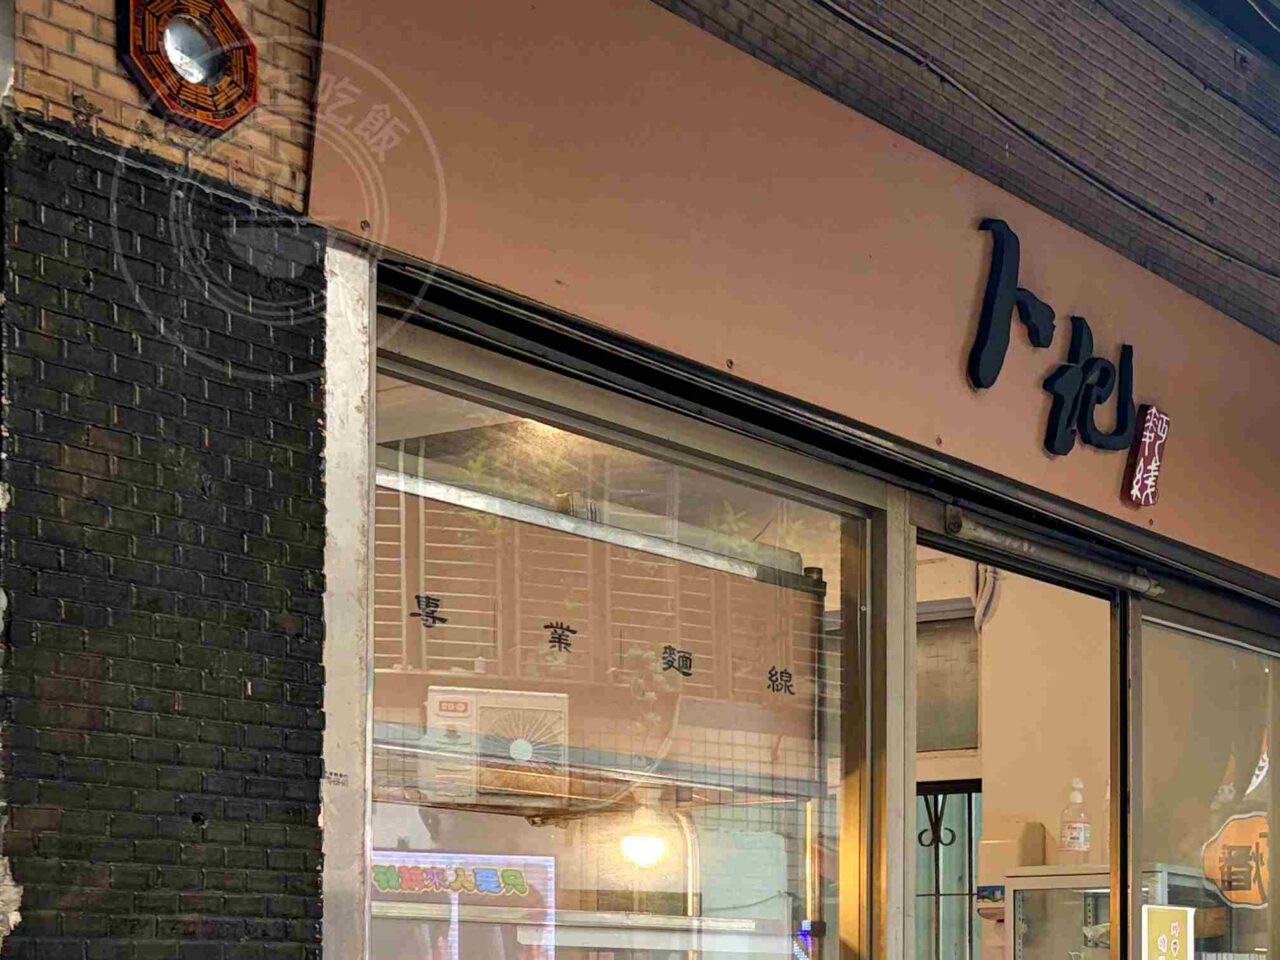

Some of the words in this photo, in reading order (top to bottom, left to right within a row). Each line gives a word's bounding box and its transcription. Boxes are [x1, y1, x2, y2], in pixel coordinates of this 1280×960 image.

[967, 217, 1136, 457] 卜記
[408, 593, 797, 697] 專業麵線
